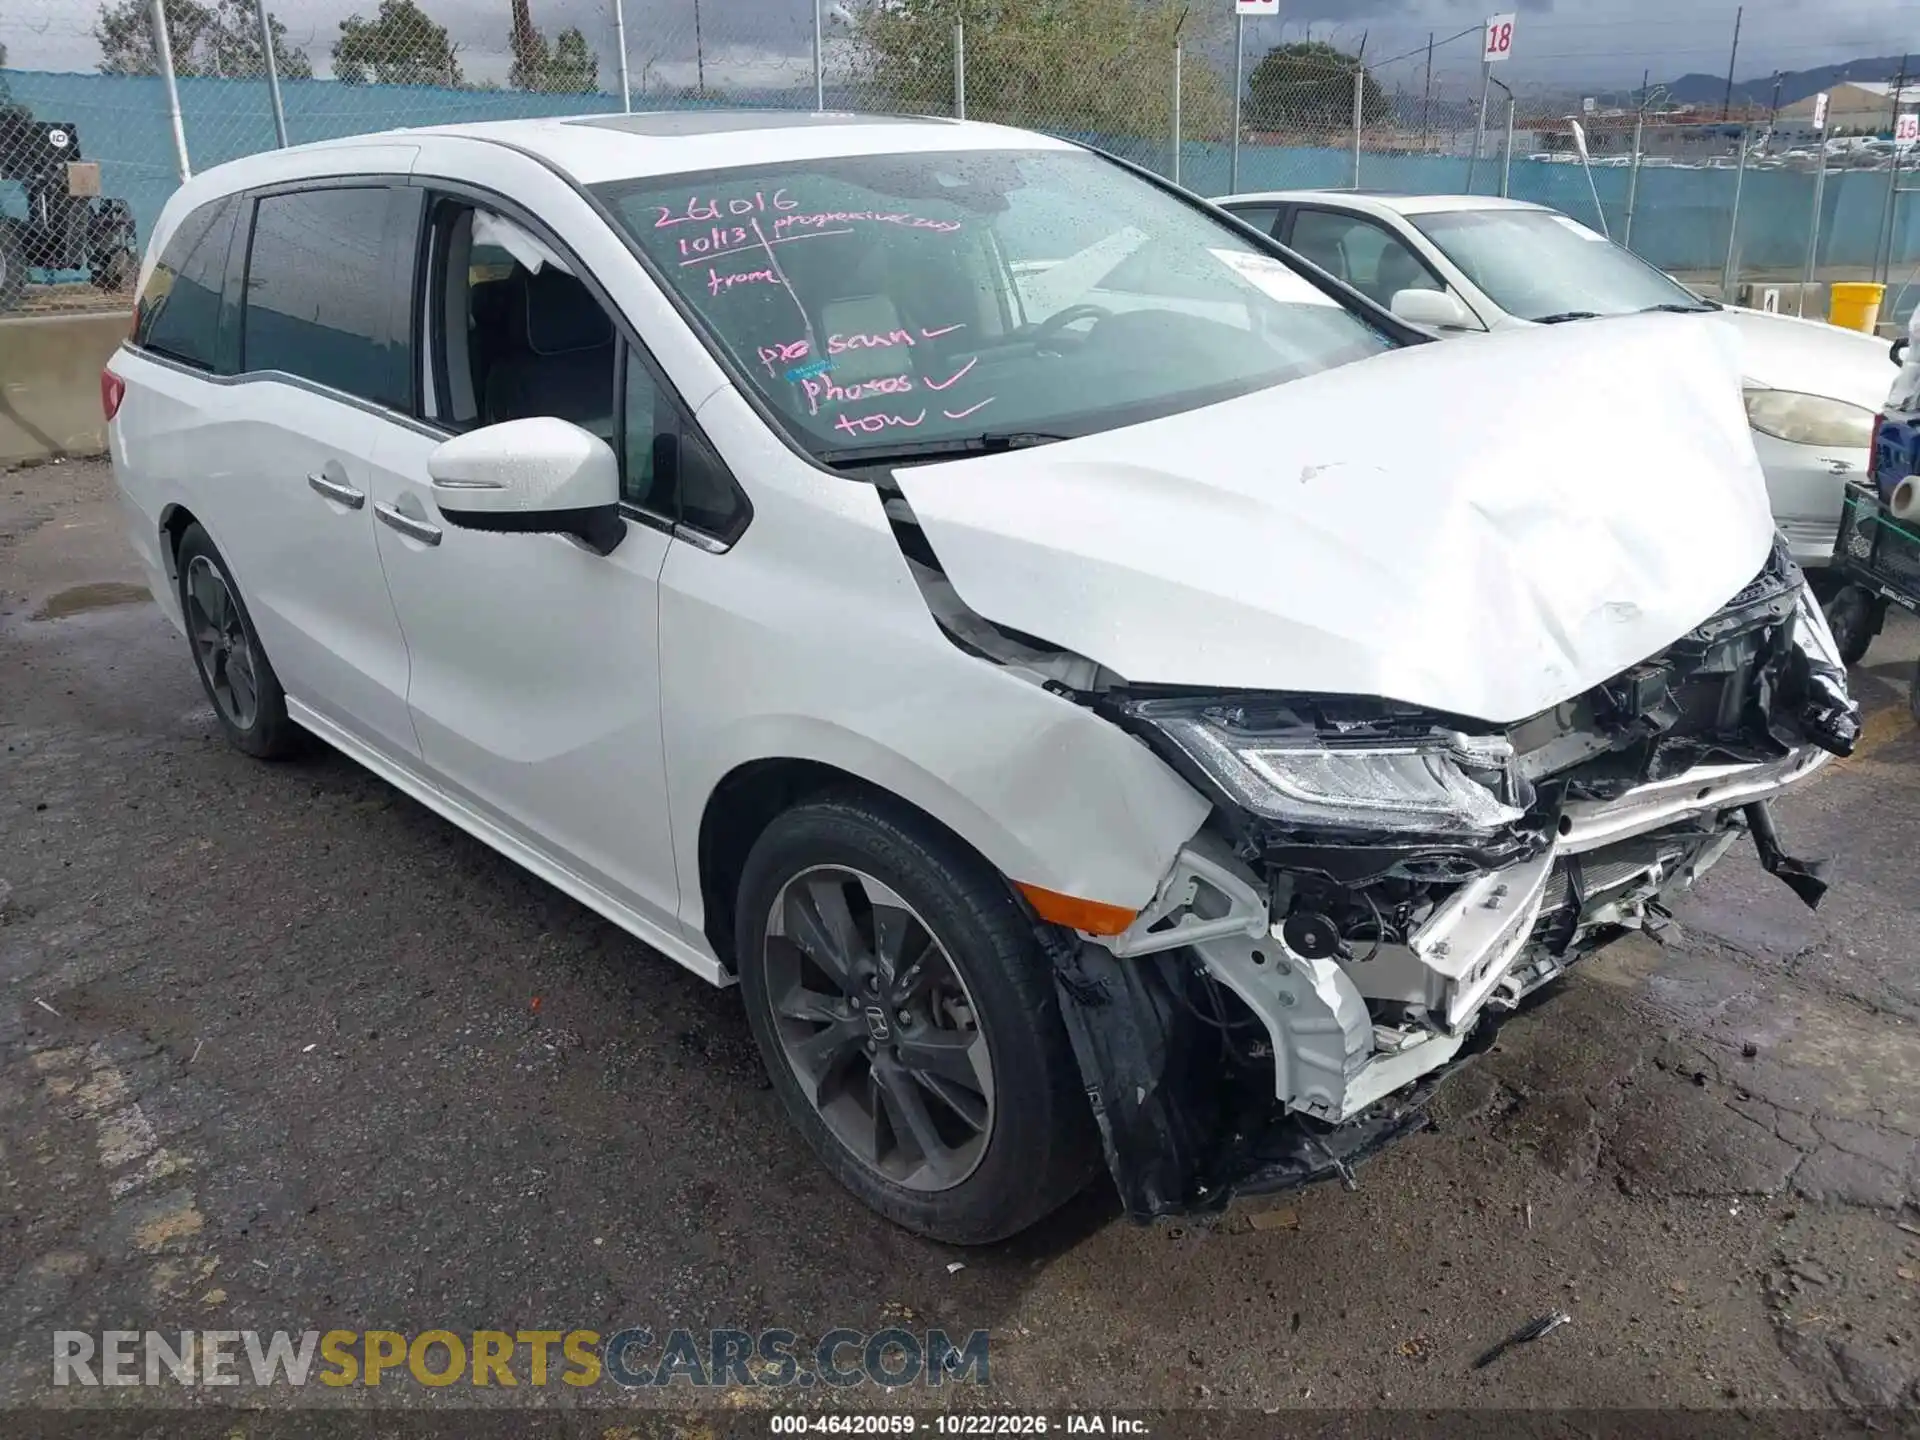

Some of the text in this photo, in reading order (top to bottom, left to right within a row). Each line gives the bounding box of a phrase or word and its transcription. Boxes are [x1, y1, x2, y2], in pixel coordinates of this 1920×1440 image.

[1487, 22, 1511, 52] 18
[1897, 120, 1916, 139] 15
[834, 408, 926, 436] tow
